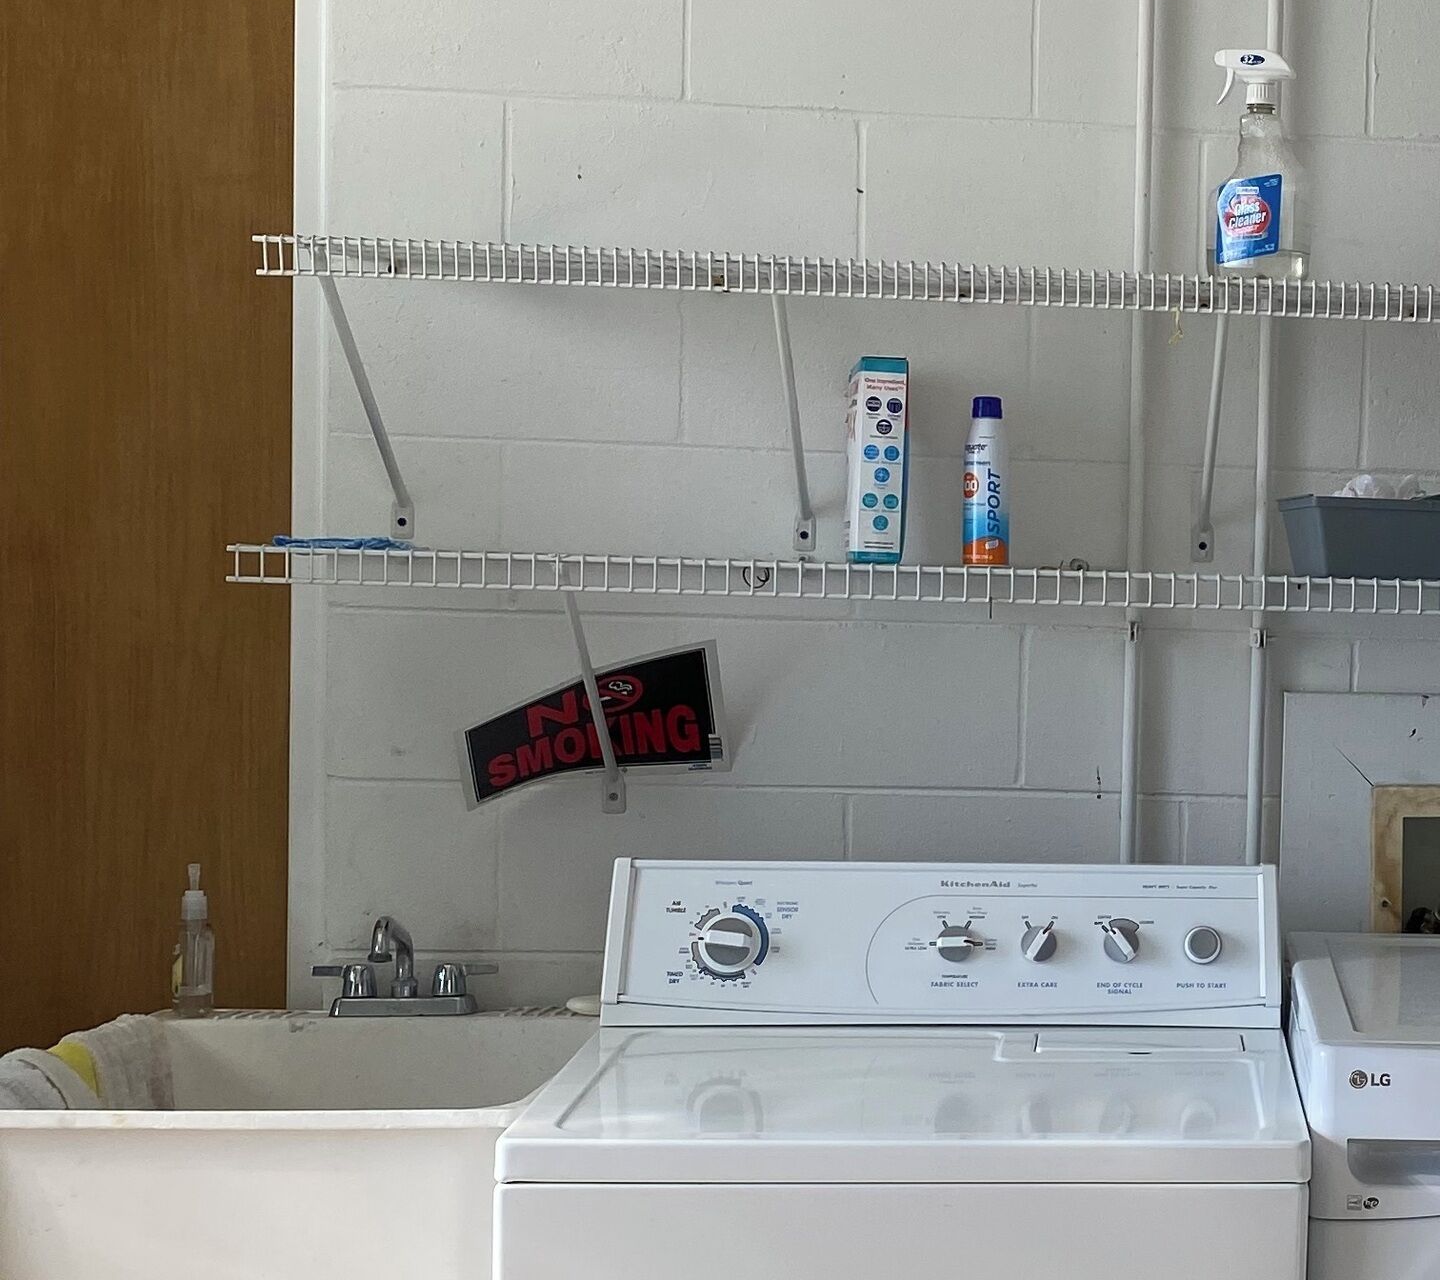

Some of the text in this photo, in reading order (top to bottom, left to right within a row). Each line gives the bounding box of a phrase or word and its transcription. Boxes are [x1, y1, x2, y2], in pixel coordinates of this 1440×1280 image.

[1229, 211, 1267, 229] Cleaner
[987, 468, 1001, 534] SPORT
[487, 704, 702, 788] SMOKING
[940, 880, 1011, 888] KitchenAid
[1371, 1073, 1391, 1087] LG
